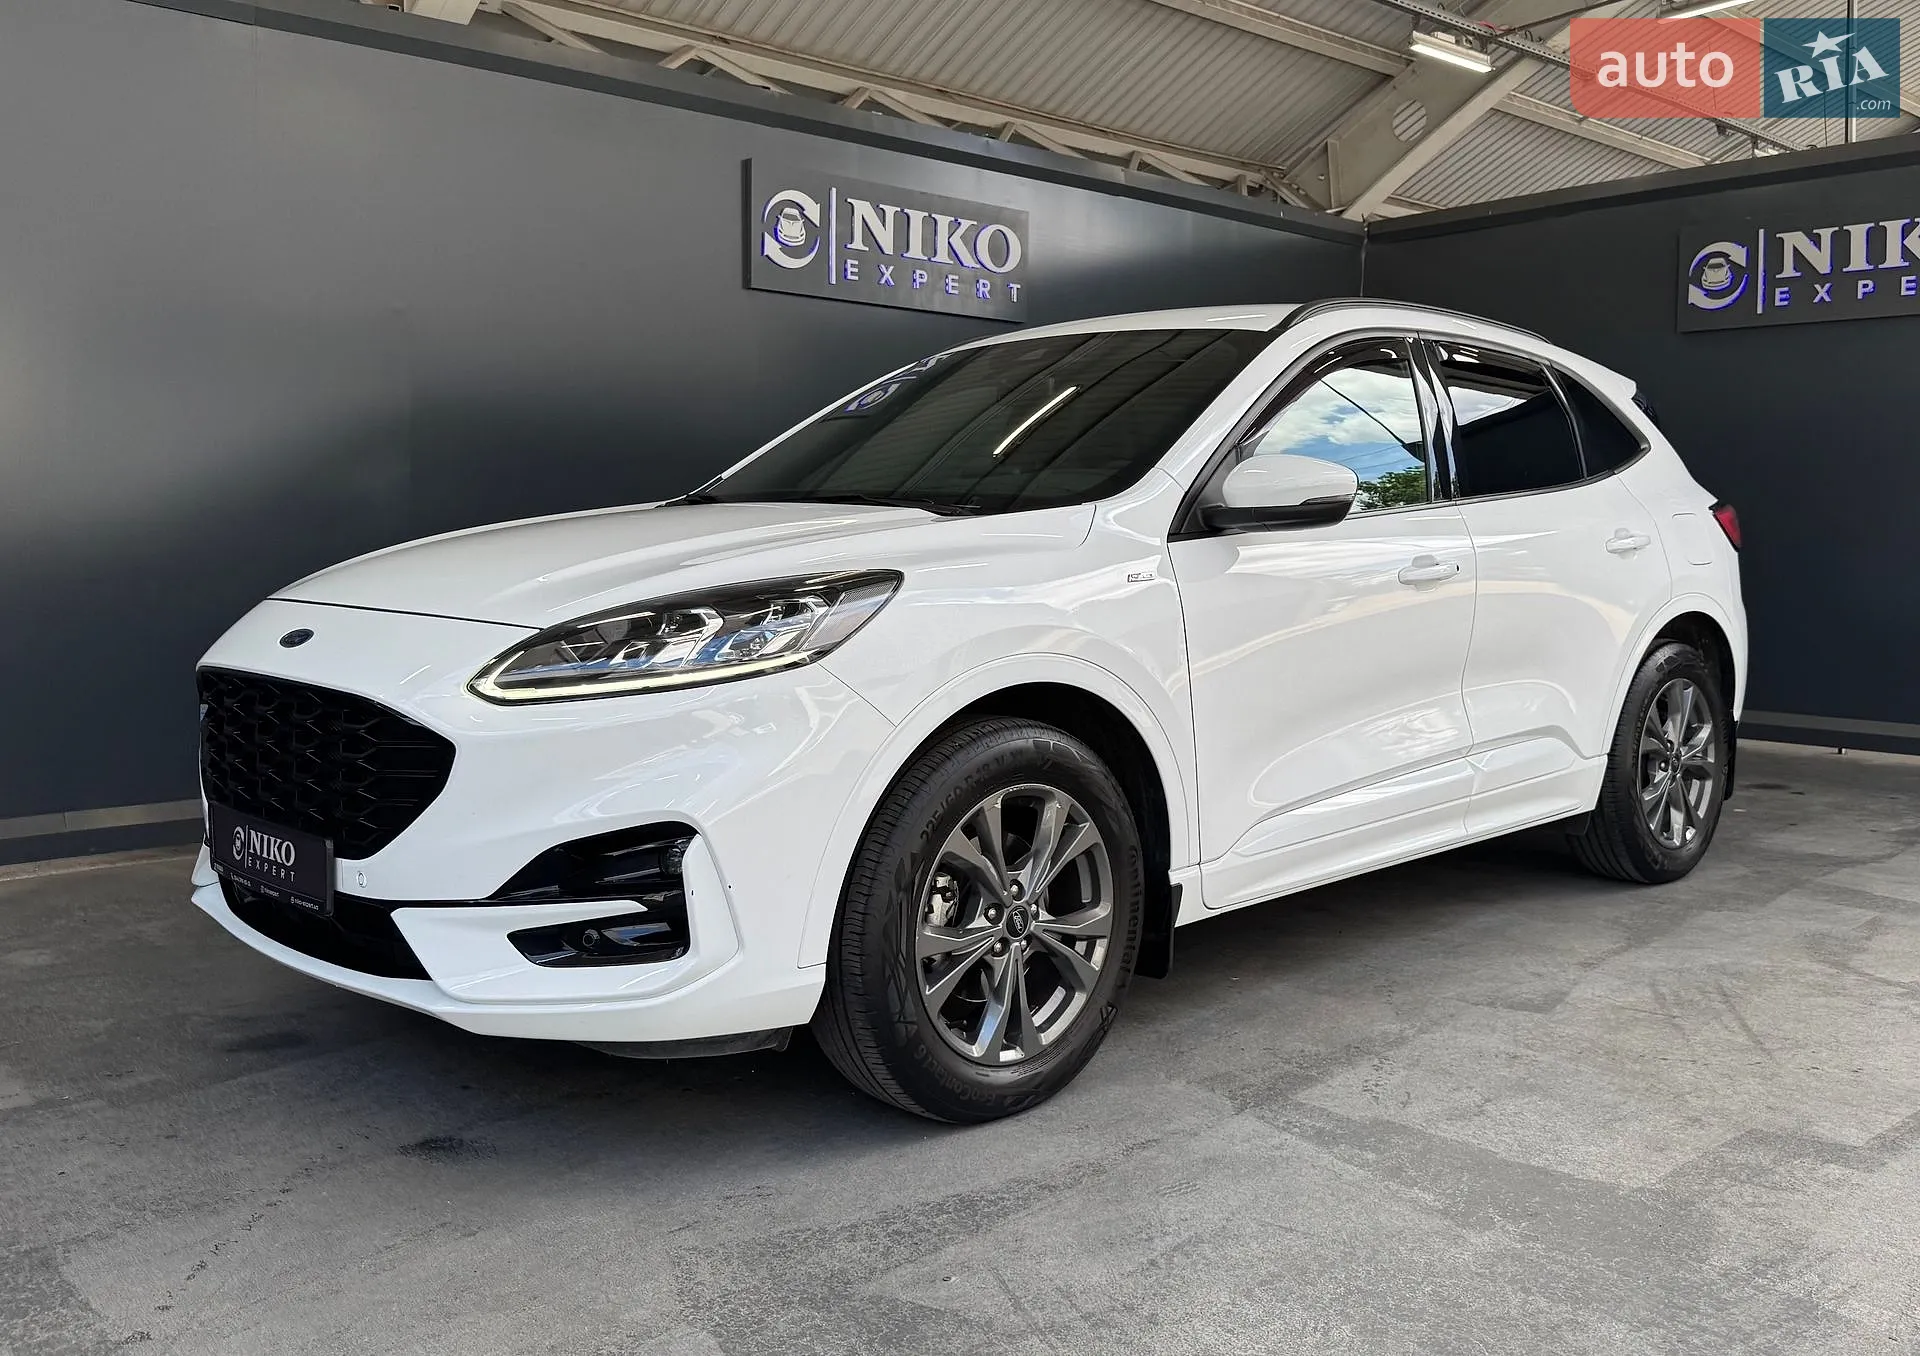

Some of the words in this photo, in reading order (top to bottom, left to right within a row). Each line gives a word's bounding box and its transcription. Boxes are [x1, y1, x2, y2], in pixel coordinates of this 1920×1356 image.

[844, 197, 1022, 274] NIKO
[844, 259, 1022, 303] EXPERT
[1774, 275, 1918, 307] EXPE
[249, 829, 295, 867] NIKO
[248, 856, 295, 882] EXPERT
